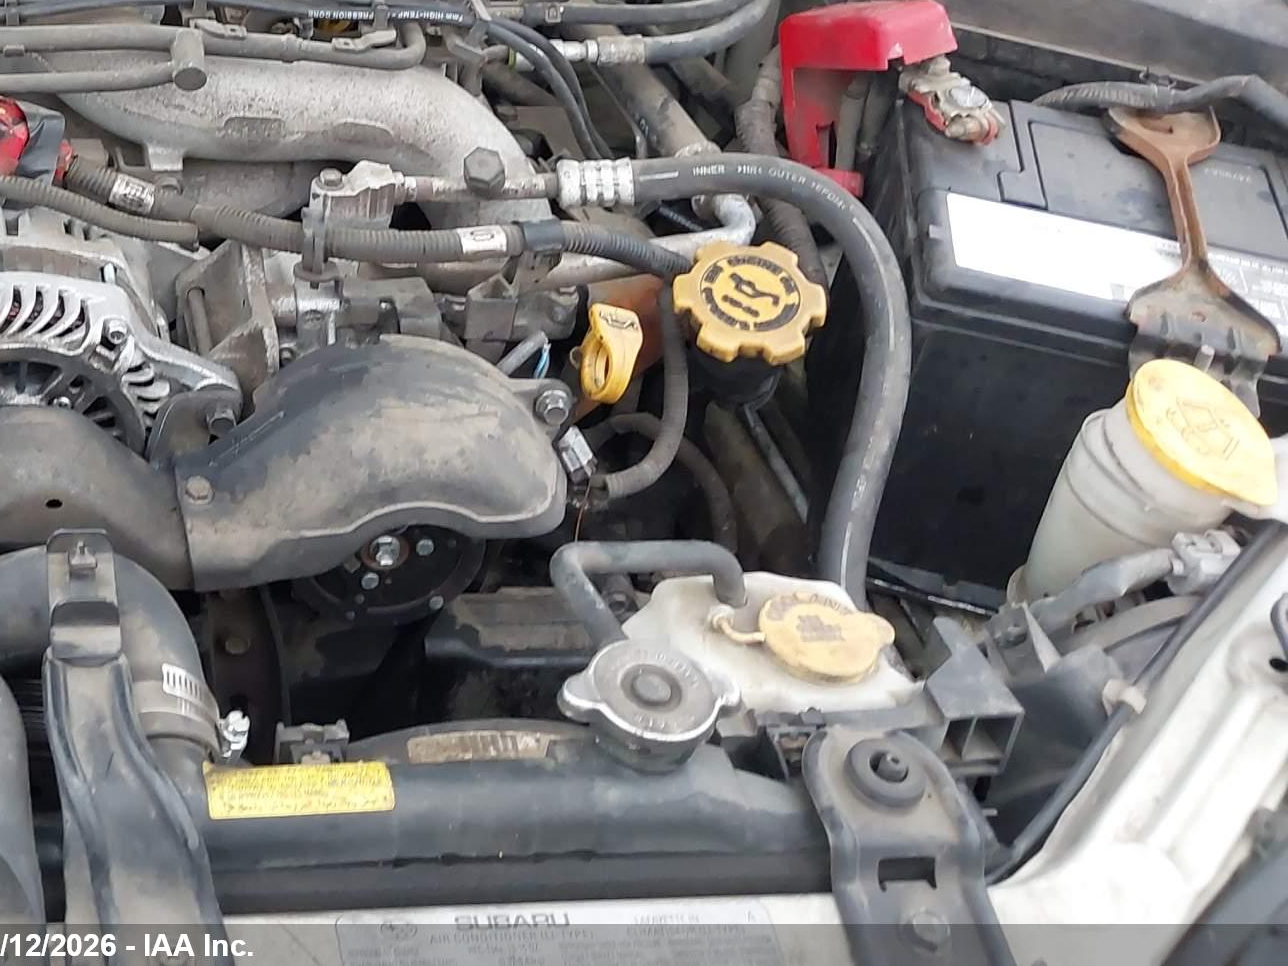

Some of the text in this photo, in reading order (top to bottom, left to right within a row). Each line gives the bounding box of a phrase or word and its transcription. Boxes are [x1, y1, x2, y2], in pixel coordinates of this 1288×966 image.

[692, 164, 725, 177] INNER
[768, 168, 806, 186] OUTER
[453, 912, 571, 931] SUBARU
